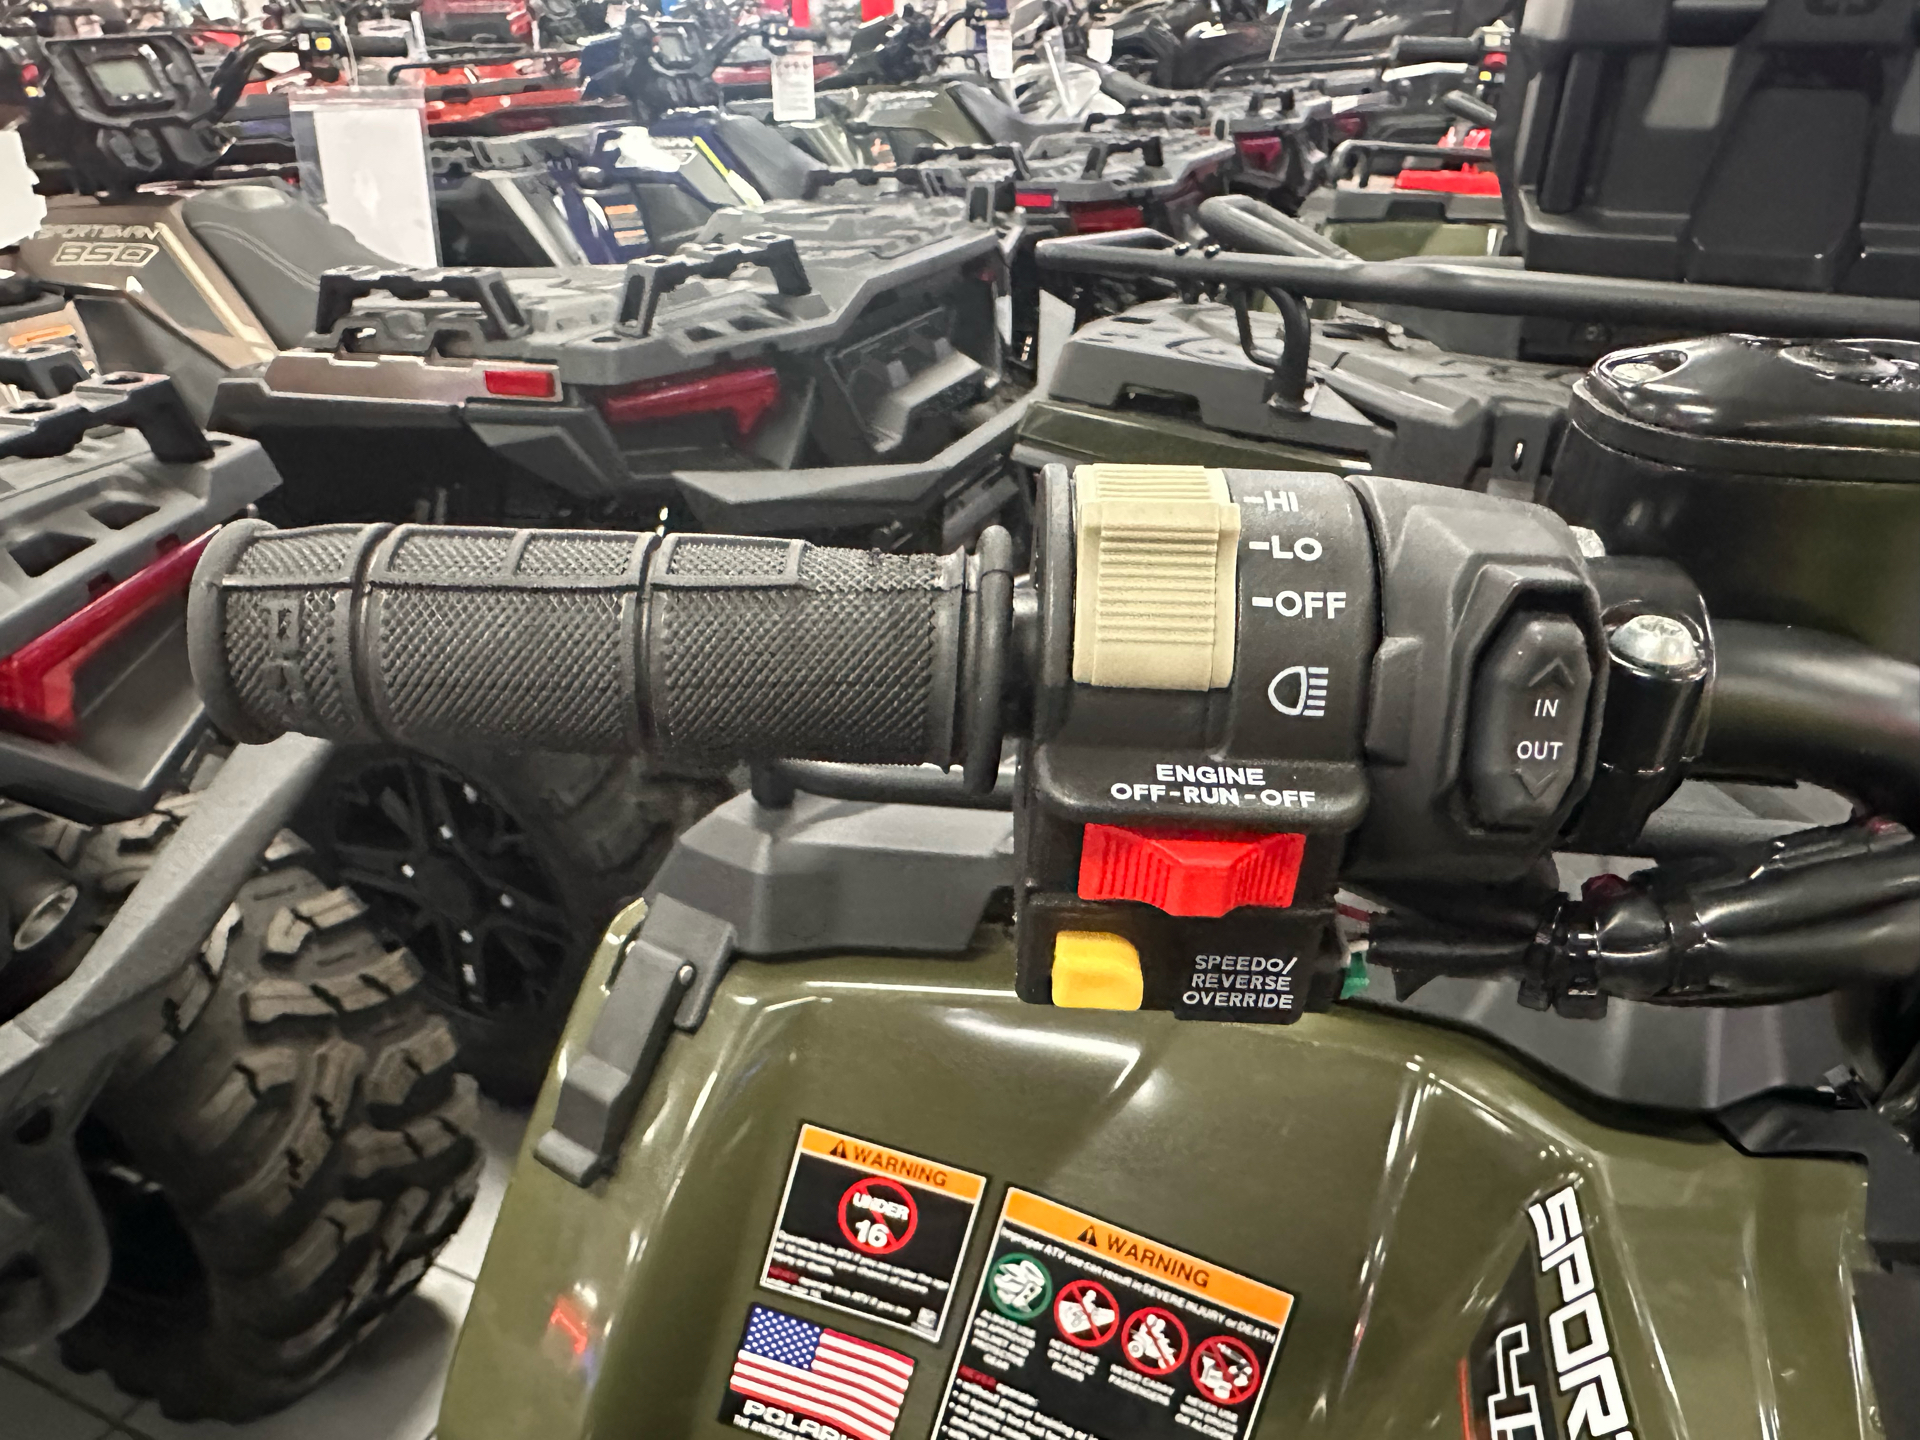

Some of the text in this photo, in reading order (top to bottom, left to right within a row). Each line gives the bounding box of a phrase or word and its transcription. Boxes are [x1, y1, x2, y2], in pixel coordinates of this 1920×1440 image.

[52, 242, 159, 268] 850
[1534, 698, 1559, 718] IN
[1516, 741, 1563, 760] OUT
[1156, 763, 1266, 786] ENGINE
[1194, 954, 1298, 974] SPEEDO/
[1191, 973, 1292, 991] REVERSE
[1182, 991, 1293, 1010] OVERRIDE
[852, 1145, 948, 1187] WARNING
[852, 1192, 910, 1220] UNDER
[855, 1219, 889, 1247] 16
[1107, 1233, 1210, 1288] WARNING
[1528, 1186, 1634, 1440] SPOR
[743, 1398, 855, 1440] POLAR
